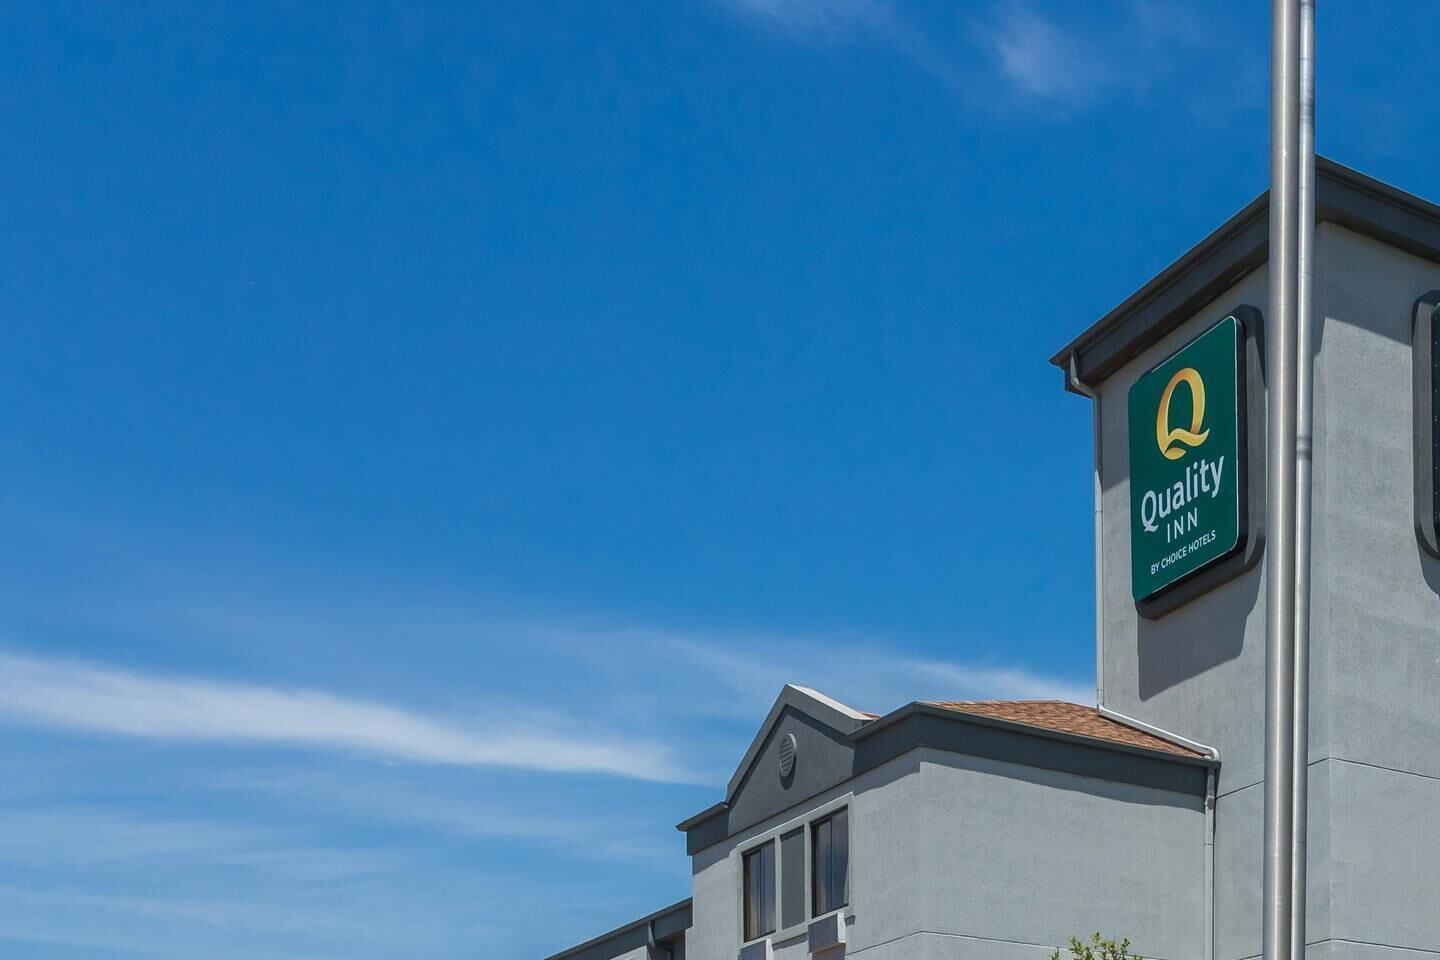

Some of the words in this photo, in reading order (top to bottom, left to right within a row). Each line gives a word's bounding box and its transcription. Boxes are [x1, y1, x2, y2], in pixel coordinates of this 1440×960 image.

[1156, 367, 1210, 460] Q
[1141, 455, 1225, 532] Quality
[1150, 562, 1161, 575] BY
[1161, 546, 1188, 569] CHOICE
[1188, 530, 1216, 554] HOTELS
[1166, 507, 1198, 543] INN
